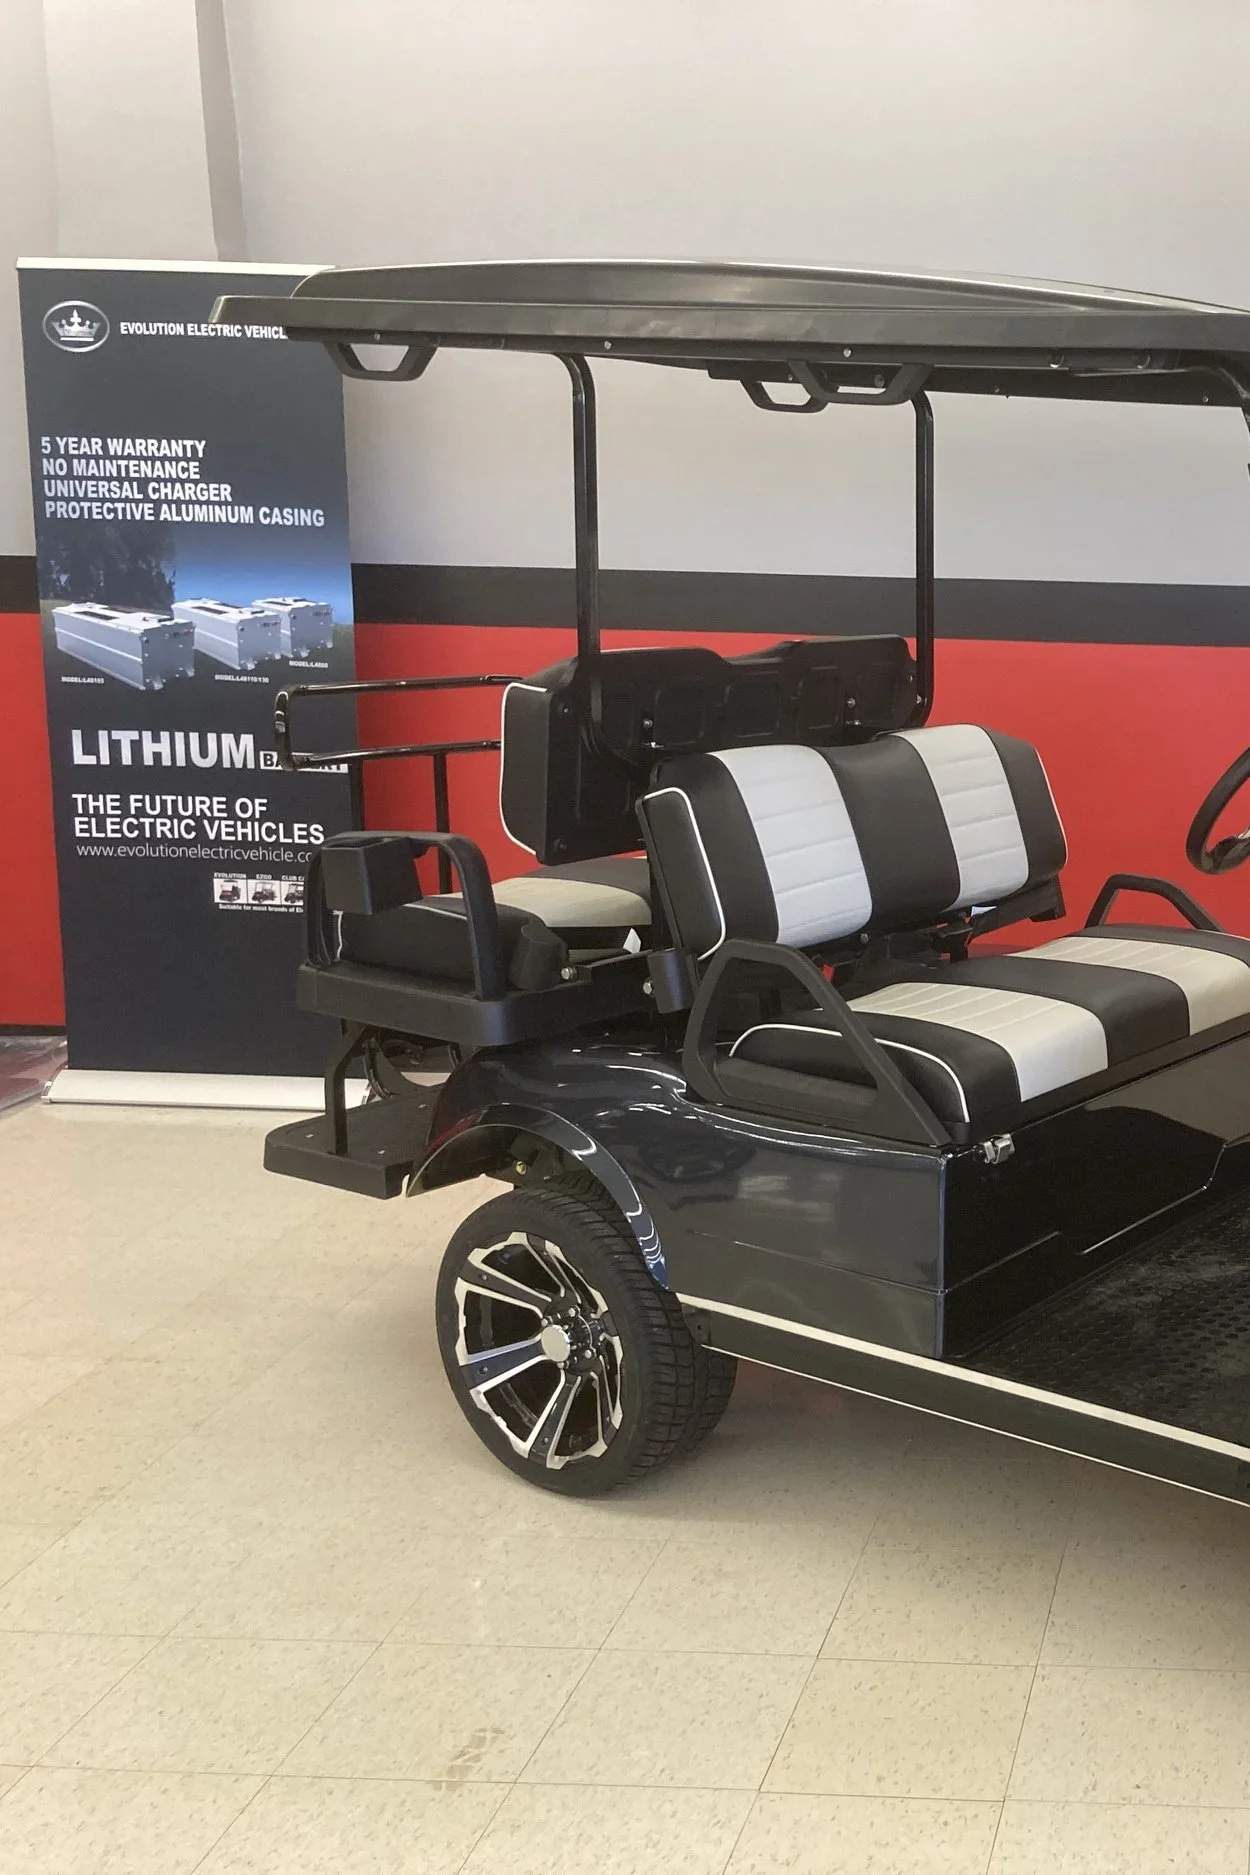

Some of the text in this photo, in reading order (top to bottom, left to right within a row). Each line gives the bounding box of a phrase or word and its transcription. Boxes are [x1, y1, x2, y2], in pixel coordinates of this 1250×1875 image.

[120, 322, 289, 340] EVOLUTION ELECTRIC VEHICL
[41, 436, 206, 458] 5 YEAR WARRANTY
[42, 458, 200, 479] NO MAINTENANCE
[44, 480, 232, 501] UNIVERSAL CHARGER
[45, 501, 325, 527] PROTECTIVE ALUMINUM CASING
[72, 729, 255, 769] LITHIUM
[72, 793, 268, 819] THE FUTURE OF
[74, 817, 325, 845] ELECTRIC VEHICLES
